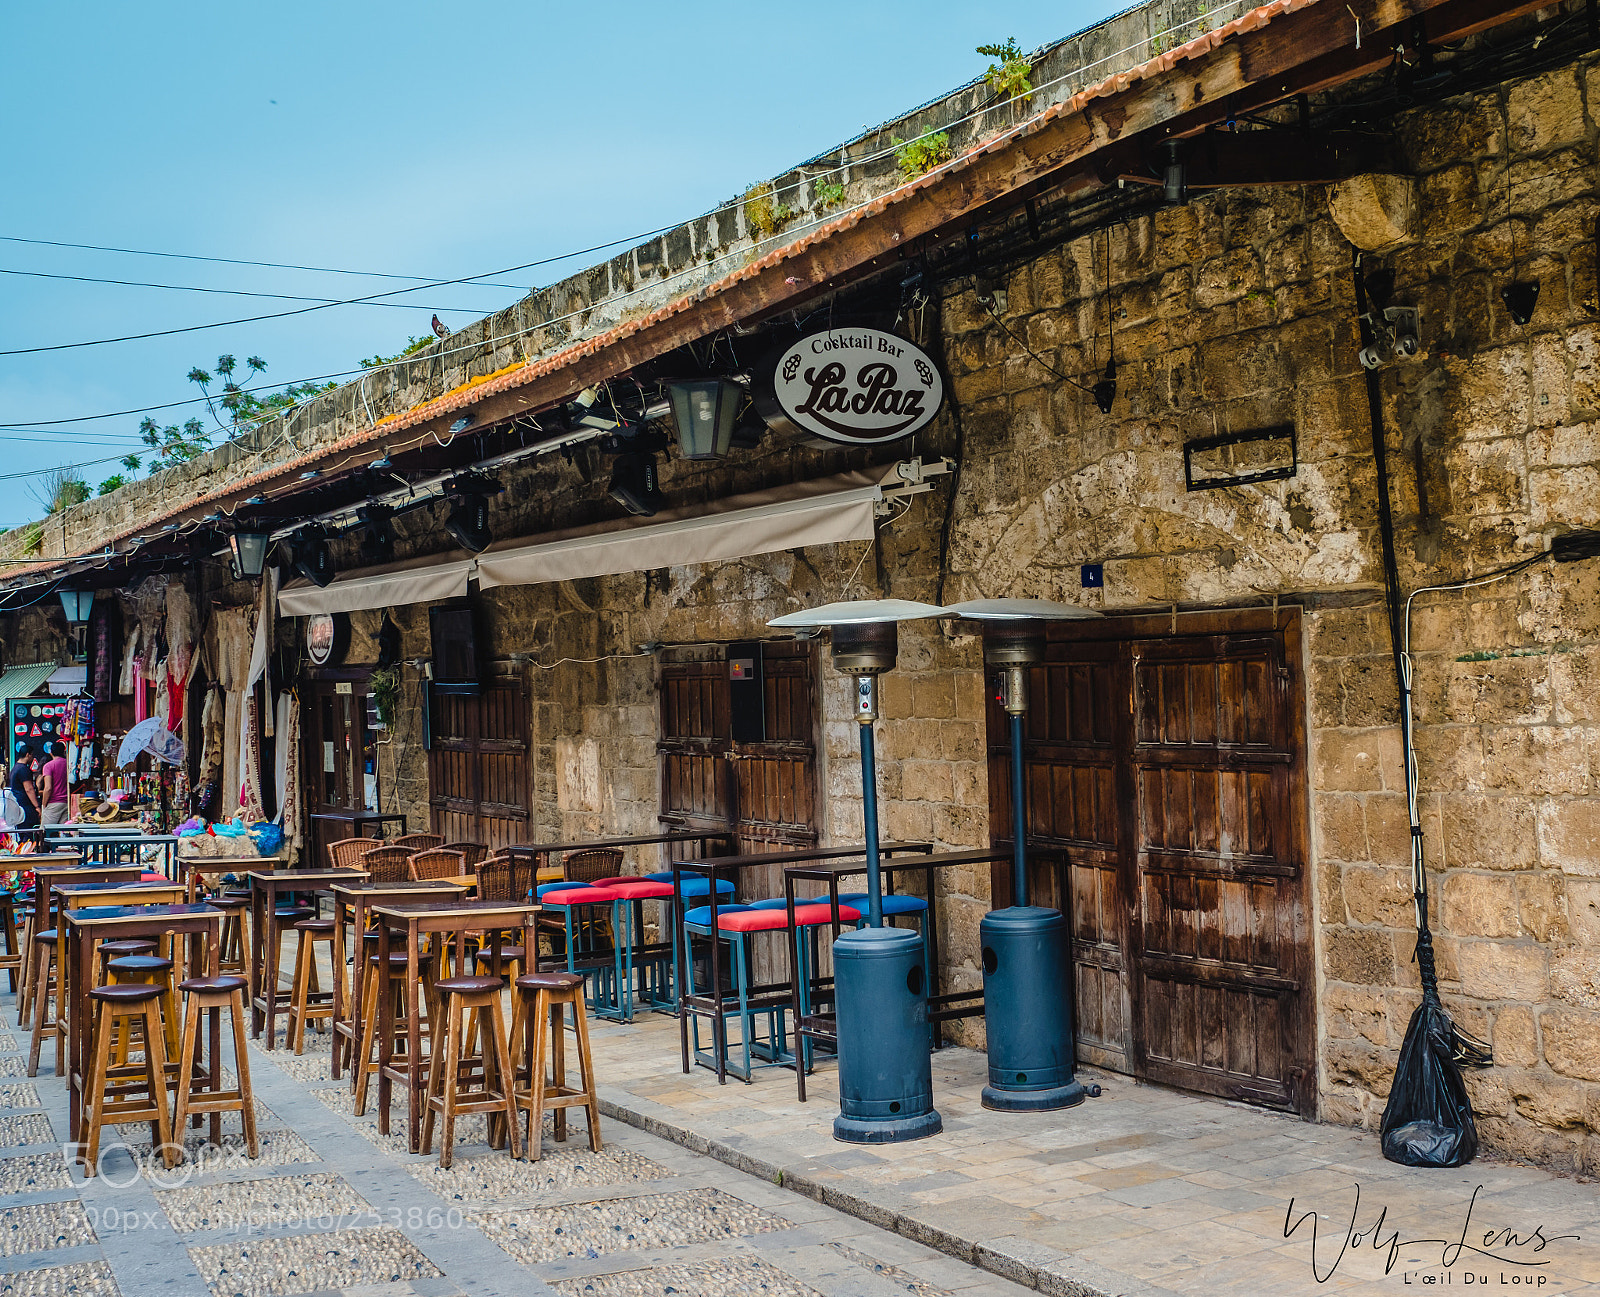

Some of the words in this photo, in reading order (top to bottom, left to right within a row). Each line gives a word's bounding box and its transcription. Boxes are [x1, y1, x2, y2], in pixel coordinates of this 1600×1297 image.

[811, 334, 873, 354] Cocktail
[877, 337, 905, 359] Bar
[794, 361, 850, 415] La
[850, 362, 926, 418] Paz
